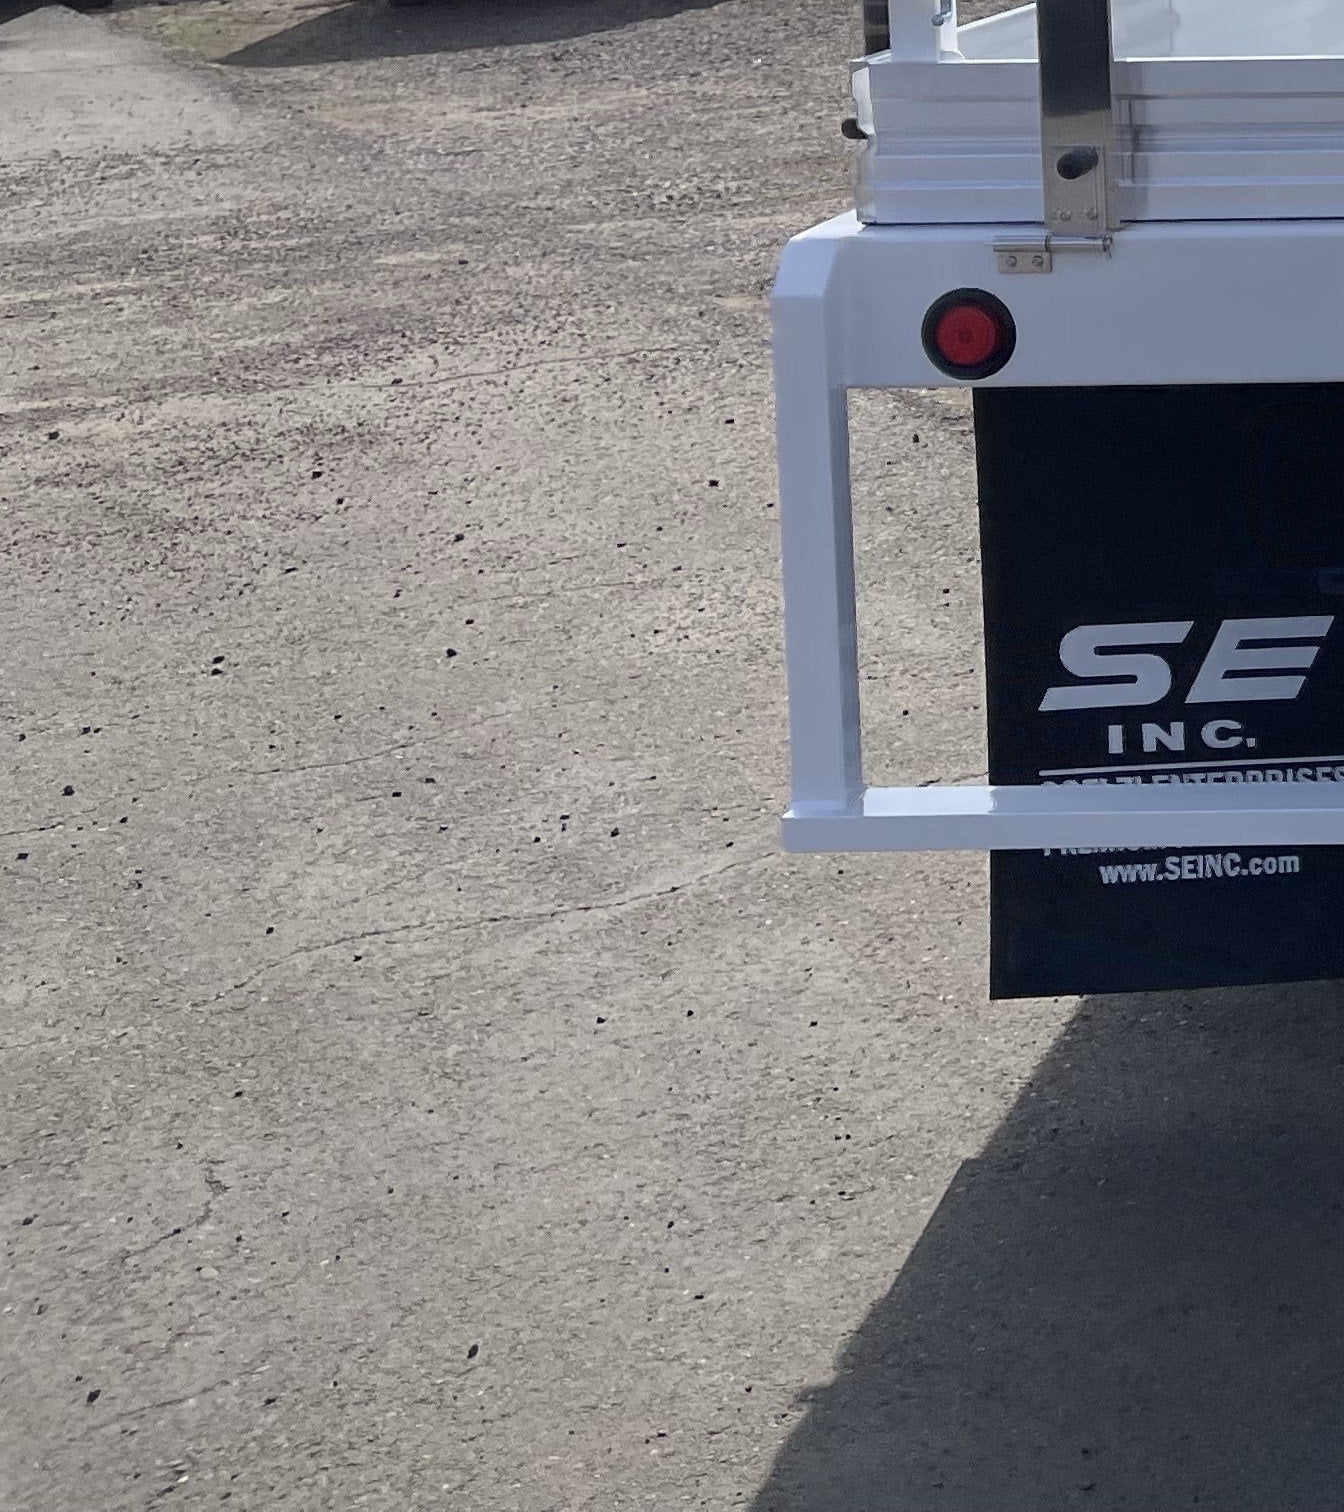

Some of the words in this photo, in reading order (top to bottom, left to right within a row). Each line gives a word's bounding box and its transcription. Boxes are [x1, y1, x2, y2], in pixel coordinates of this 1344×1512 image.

[1037, 615, 1335, 711] SE
[1107, 719, 1256, 754] INC.
[1099, 852, 1300, 884] www.SEINC.com
